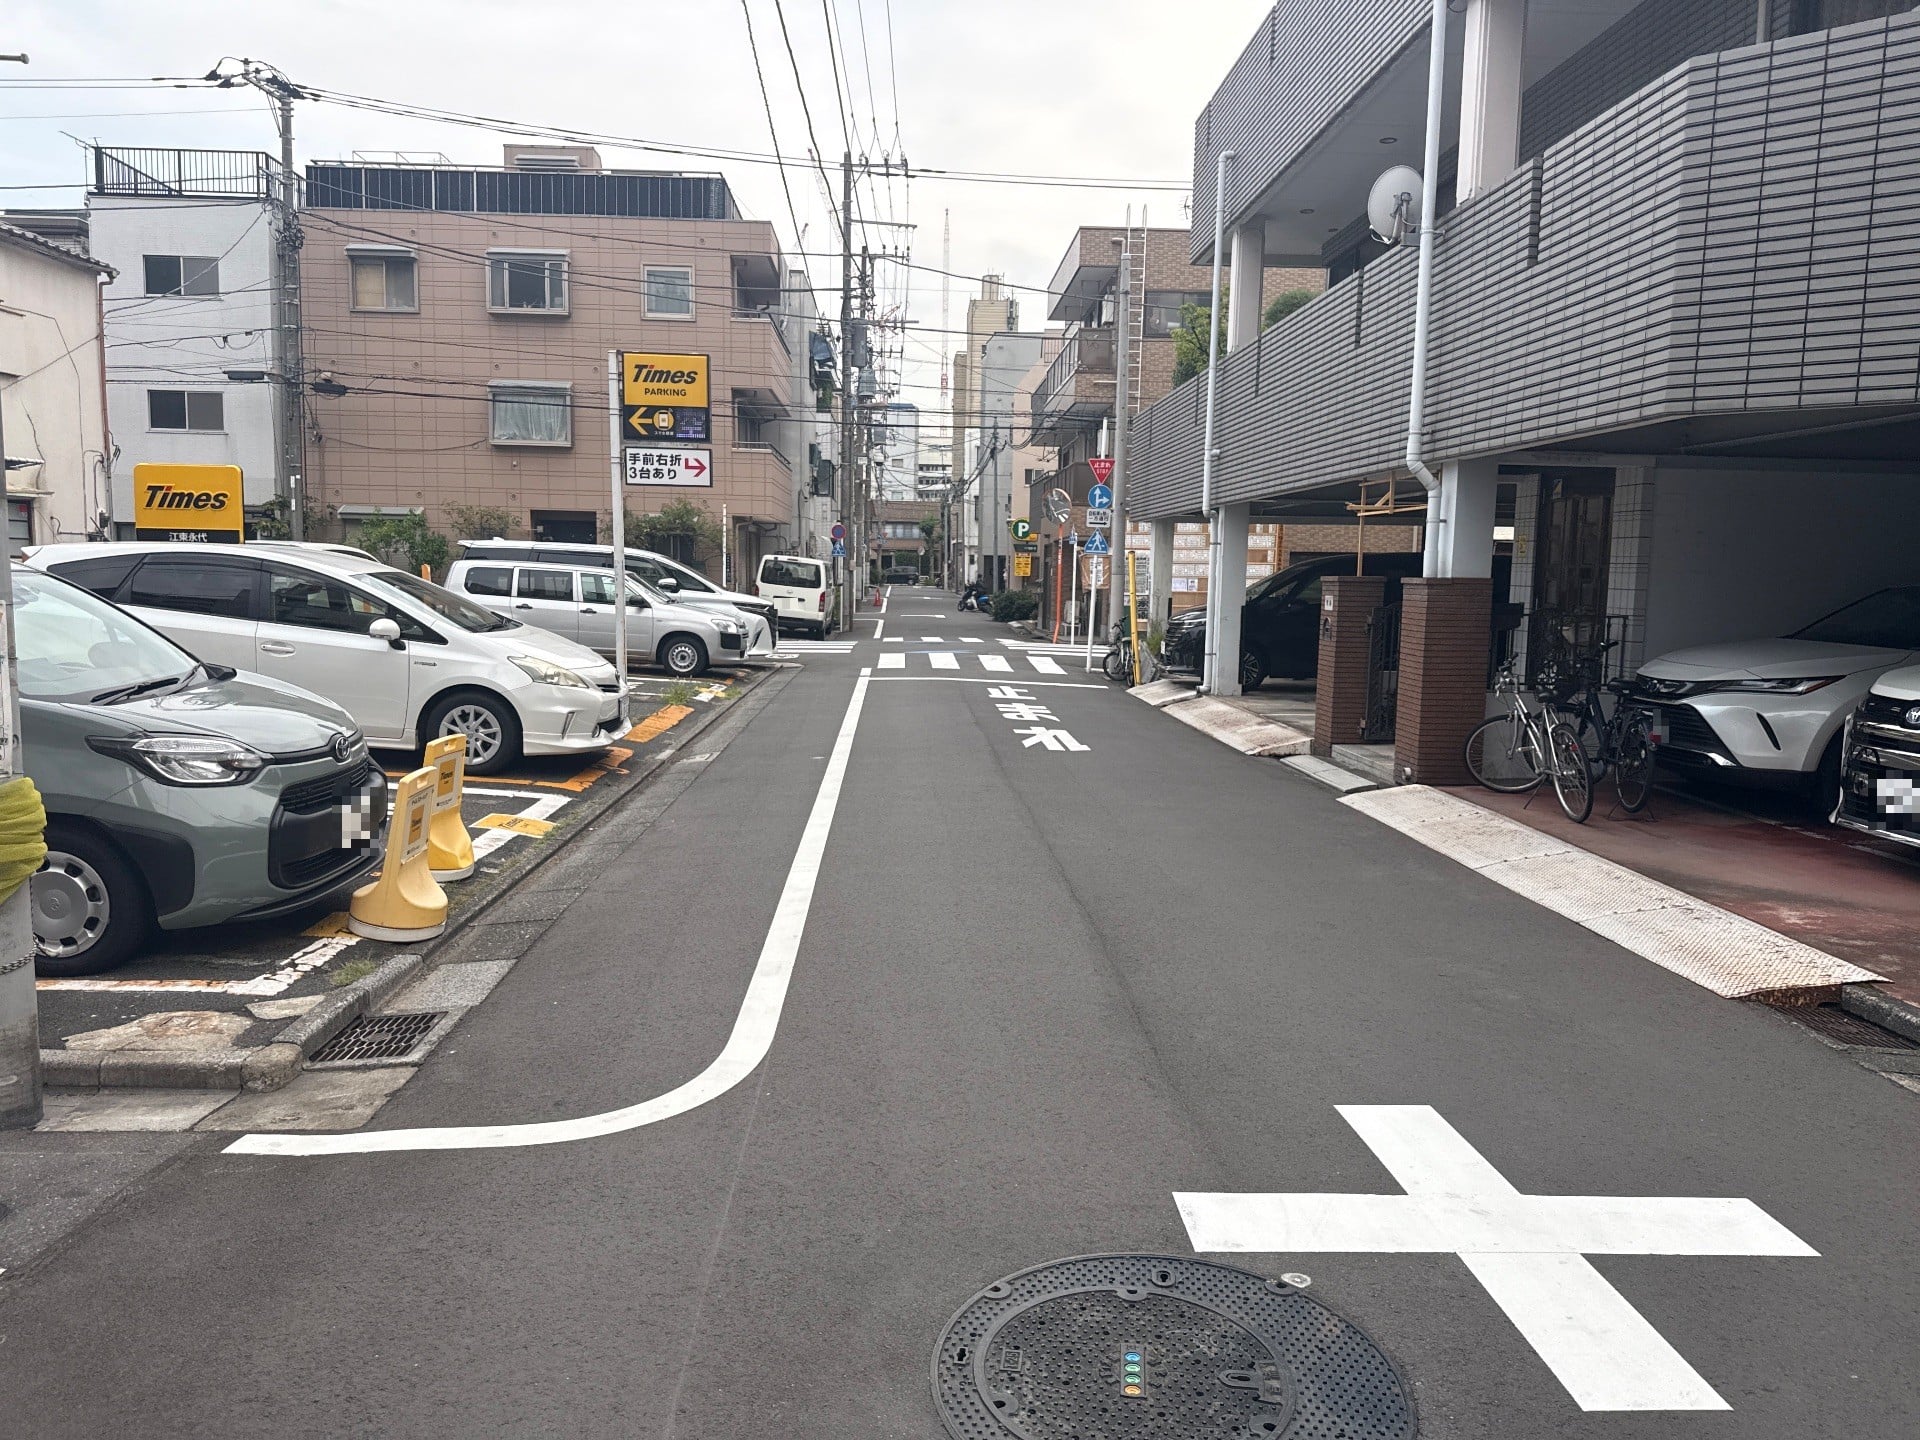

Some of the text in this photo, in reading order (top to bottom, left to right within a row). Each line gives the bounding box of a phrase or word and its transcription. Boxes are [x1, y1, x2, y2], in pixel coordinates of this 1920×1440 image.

[633, 364, 699, 384] Times
[644, 387, 687, 397] PARKING
[628, 453, 682, 467] 手前右折
[628, 466, 677, 480] 3台あり
[145, 485, 229, 510] Times
[1018, 522, 1029, 537] P
[168, 531, 208, 543] 江東永代
[986, 685, 1092, 752] 止まれ
